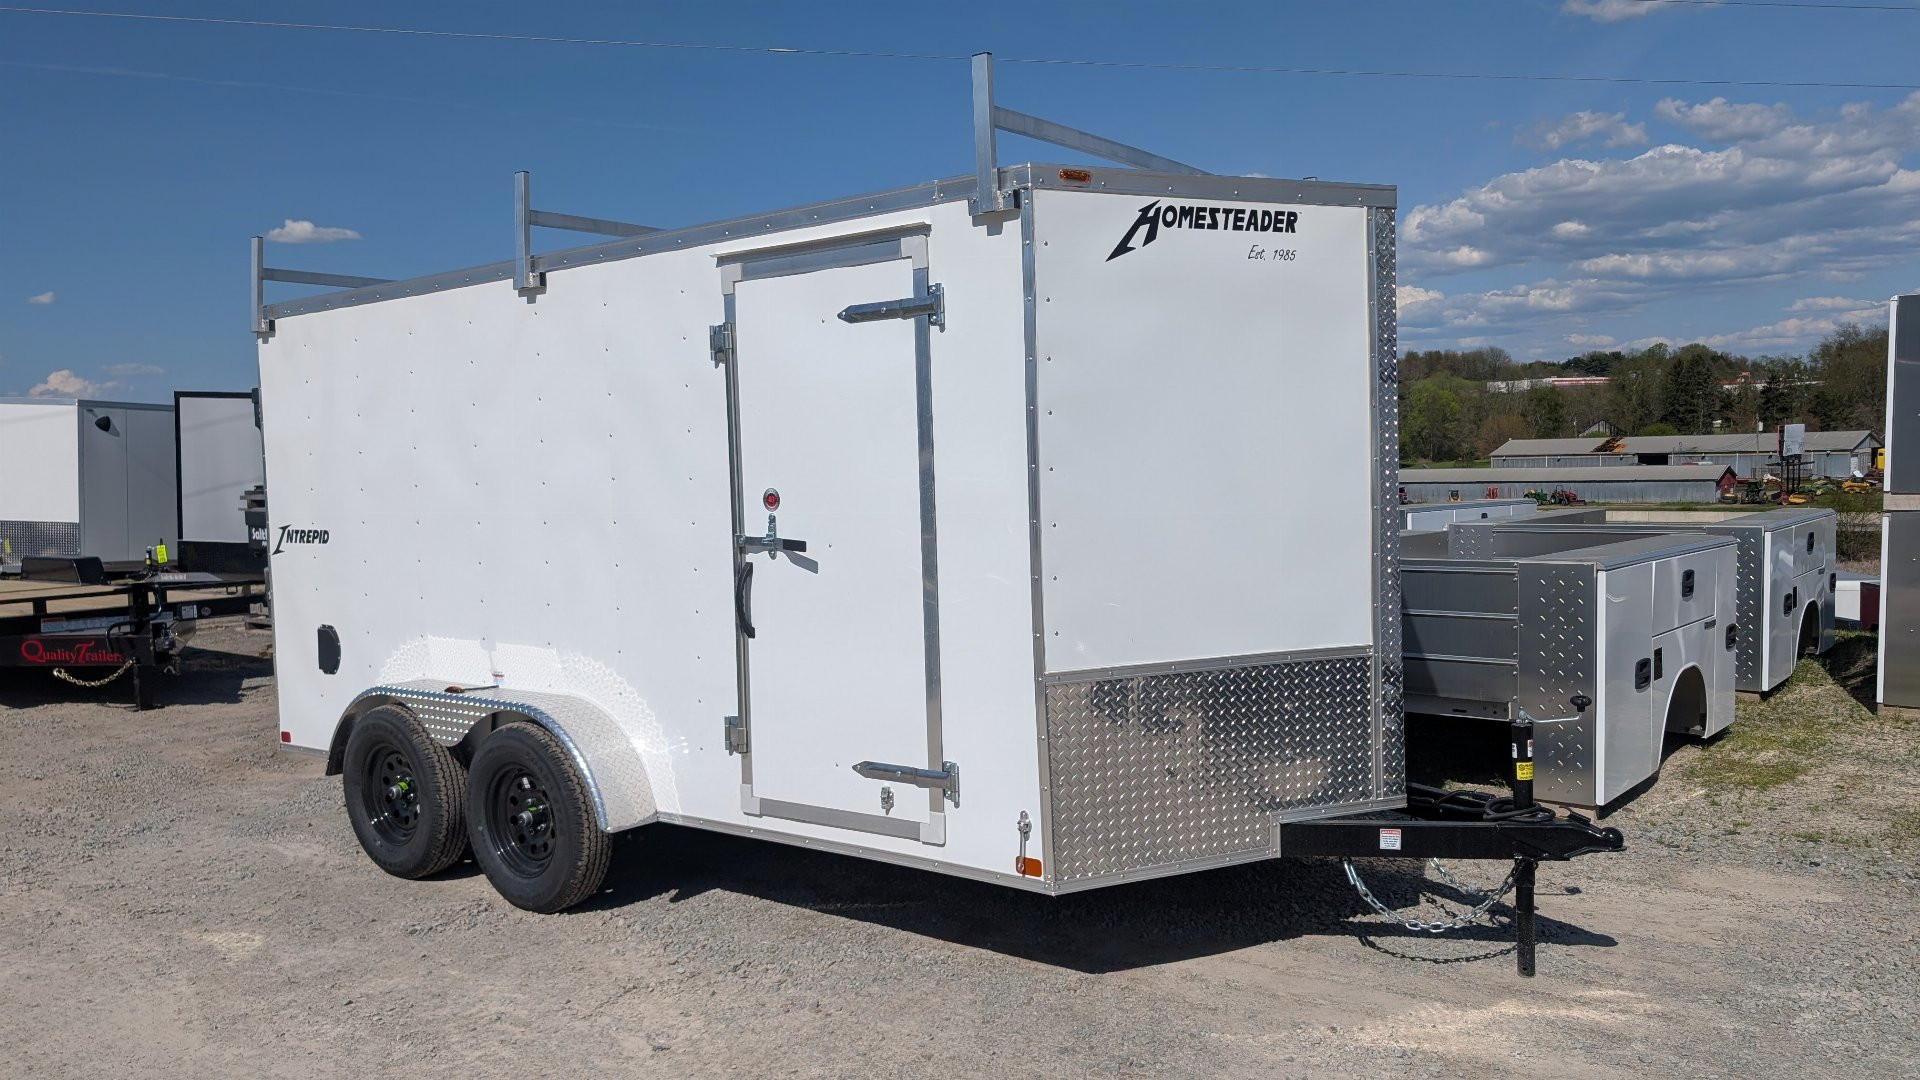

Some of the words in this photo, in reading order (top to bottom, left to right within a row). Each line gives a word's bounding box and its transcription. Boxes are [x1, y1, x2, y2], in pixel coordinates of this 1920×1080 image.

[1105, 199, 1298, 263] HOMESTEADER
[1248, 244, 1266, 261] Est.
[1273, 249, 1297, 262] 1985
[271, 523, 330, 556] INTREPID
